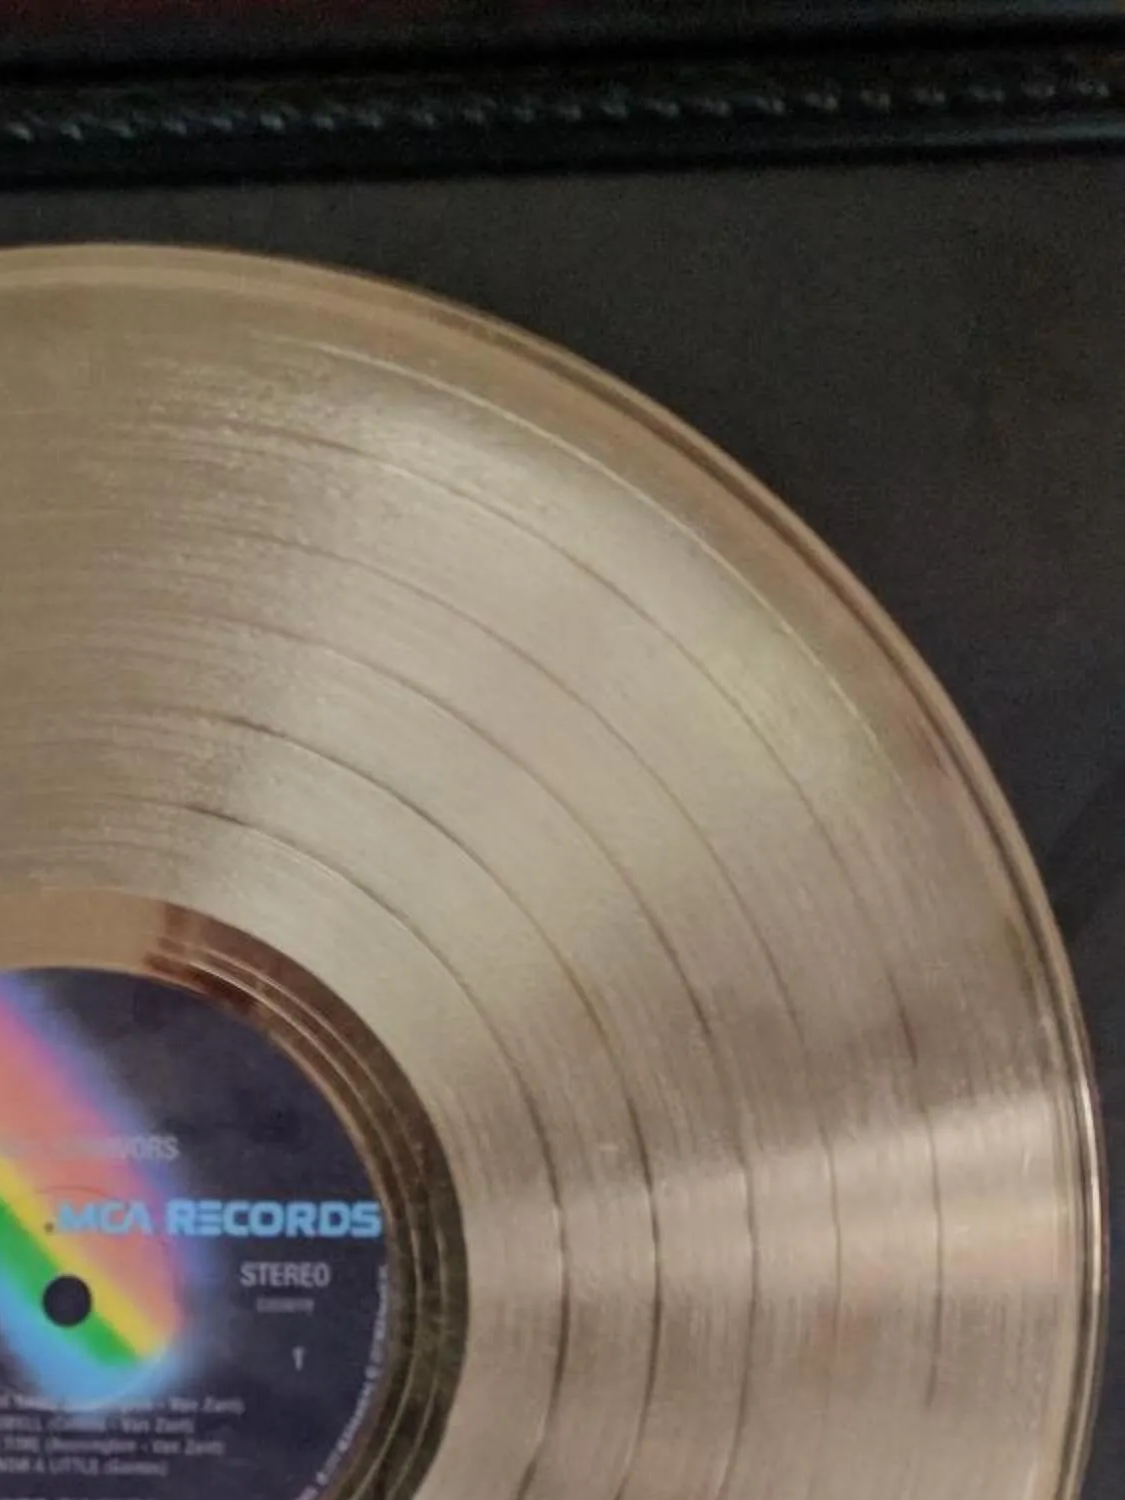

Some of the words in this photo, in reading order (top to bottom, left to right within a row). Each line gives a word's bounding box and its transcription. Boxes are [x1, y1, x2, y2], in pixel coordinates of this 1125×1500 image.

[55, 1199, 153, 1235] MCA
[166, 1198, 382, 1238] RECORDS
[240, 1261, 331, 1288] STEREO
